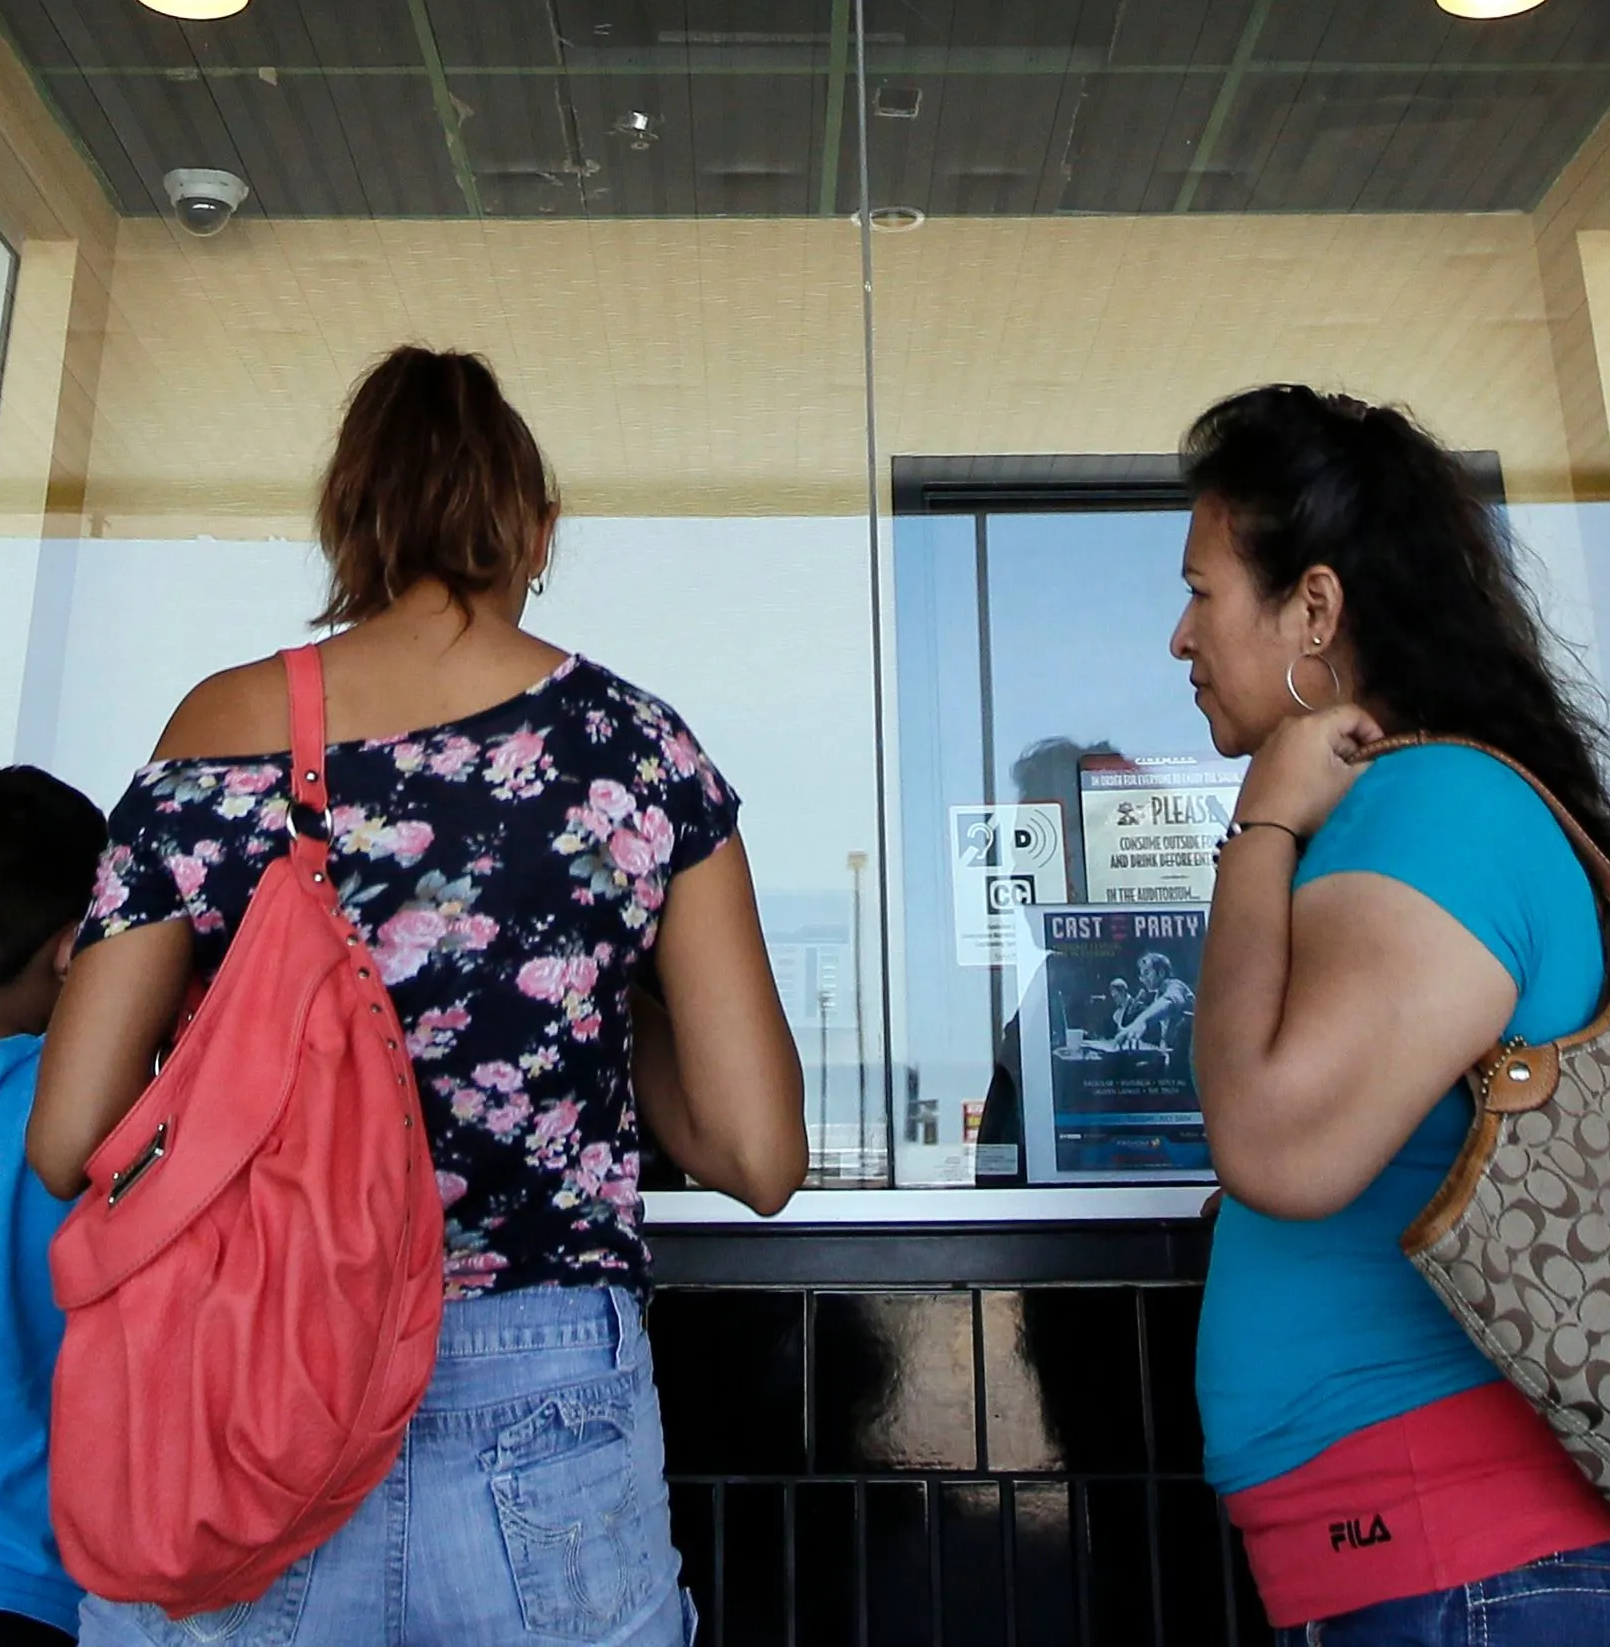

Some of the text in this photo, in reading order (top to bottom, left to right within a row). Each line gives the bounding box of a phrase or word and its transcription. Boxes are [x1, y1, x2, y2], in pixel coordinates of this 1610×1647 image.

[1120, 835, 1200, 851] CONSUME OUTSIDE
[1110, 853, 1192, 869] AND DRINK BEFORE
[1106, 889, 1116, 902] IN
[1118, 888, 1136, 902] THE
[1052, 915, 1198, 939] CAST PARTY
[1328, 1514, 1392, 1553] FILA
